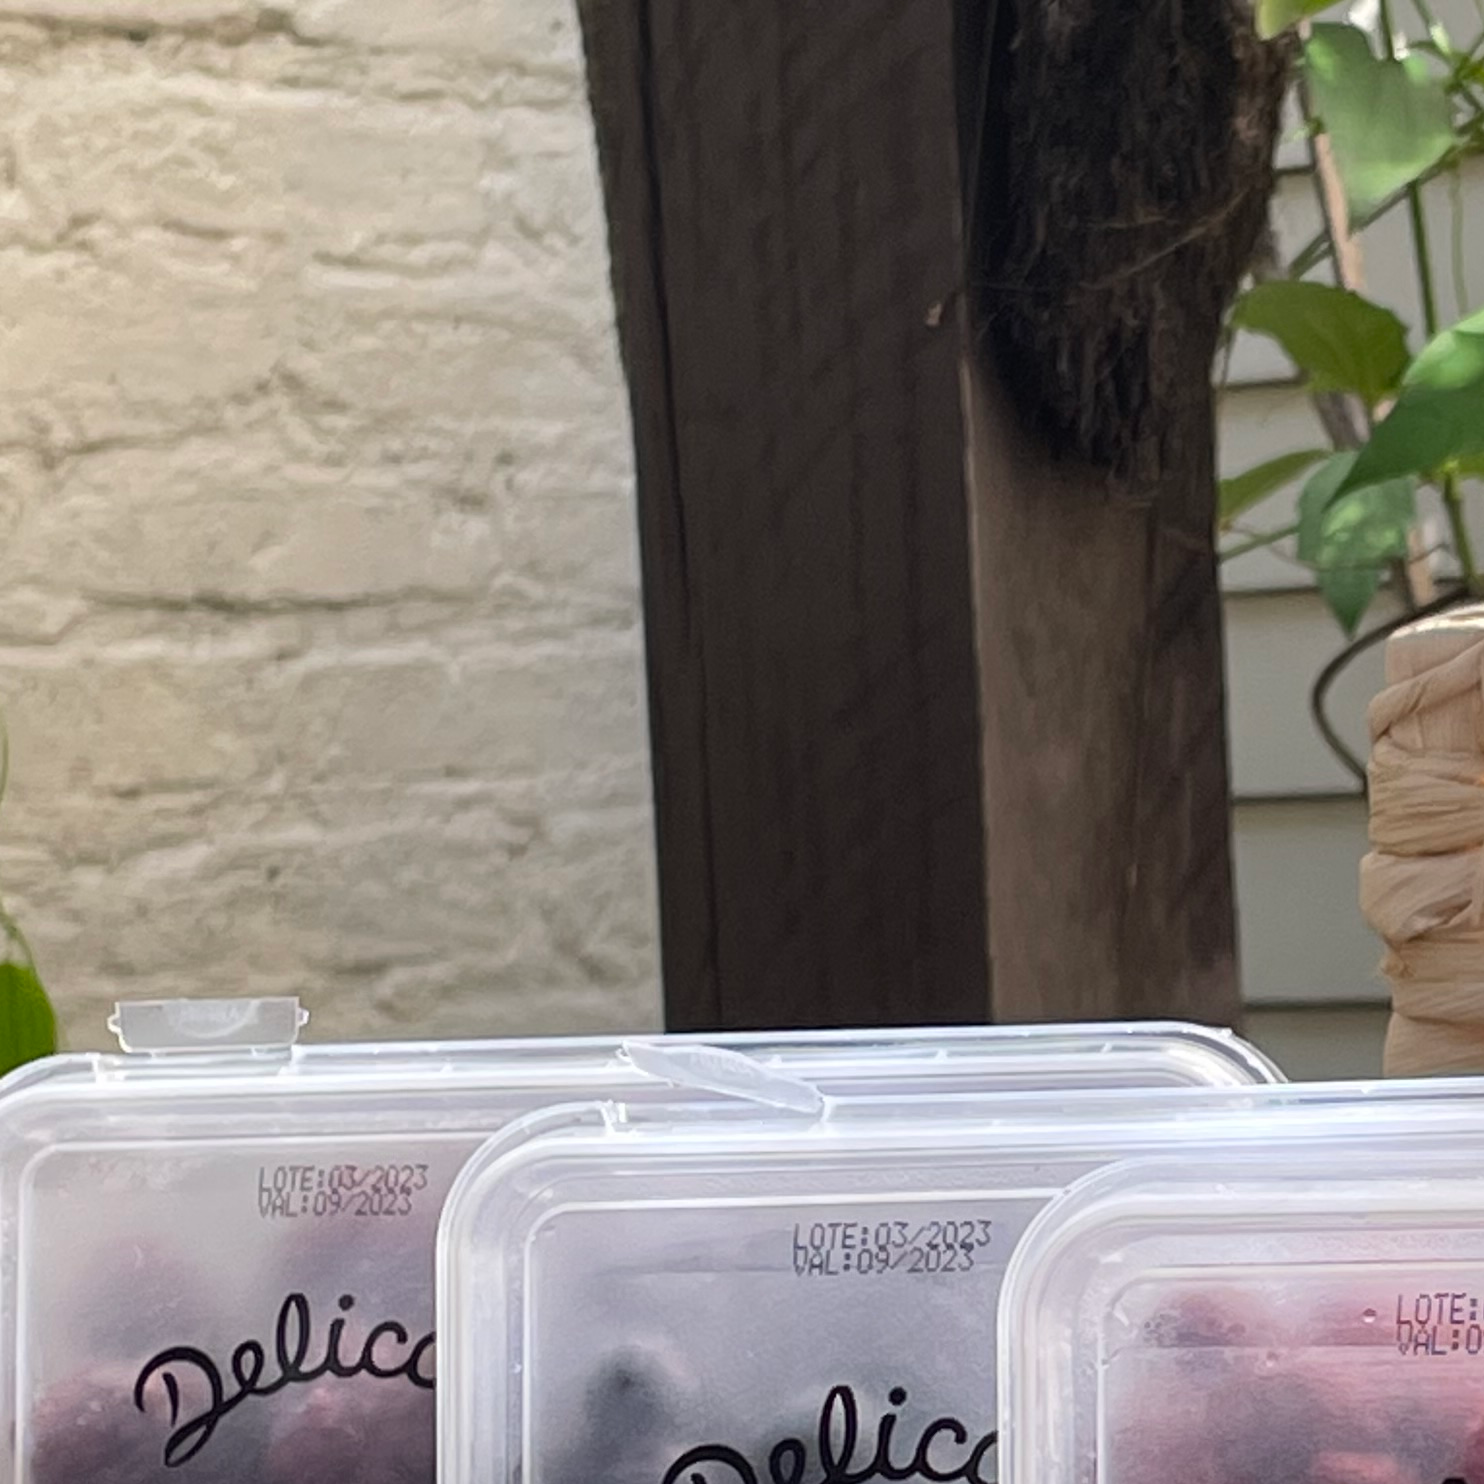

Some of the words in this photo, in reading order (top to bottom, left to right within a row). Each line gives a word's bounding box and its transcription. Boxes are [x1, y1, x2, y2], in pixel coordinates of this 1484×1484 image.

[258, 1164, 430, 1193] LOTE:03/2023
[793, 1219, 992, 1248] LOTE:03/2023
[793, 1245, 975, 1275] VAL:09/2023
